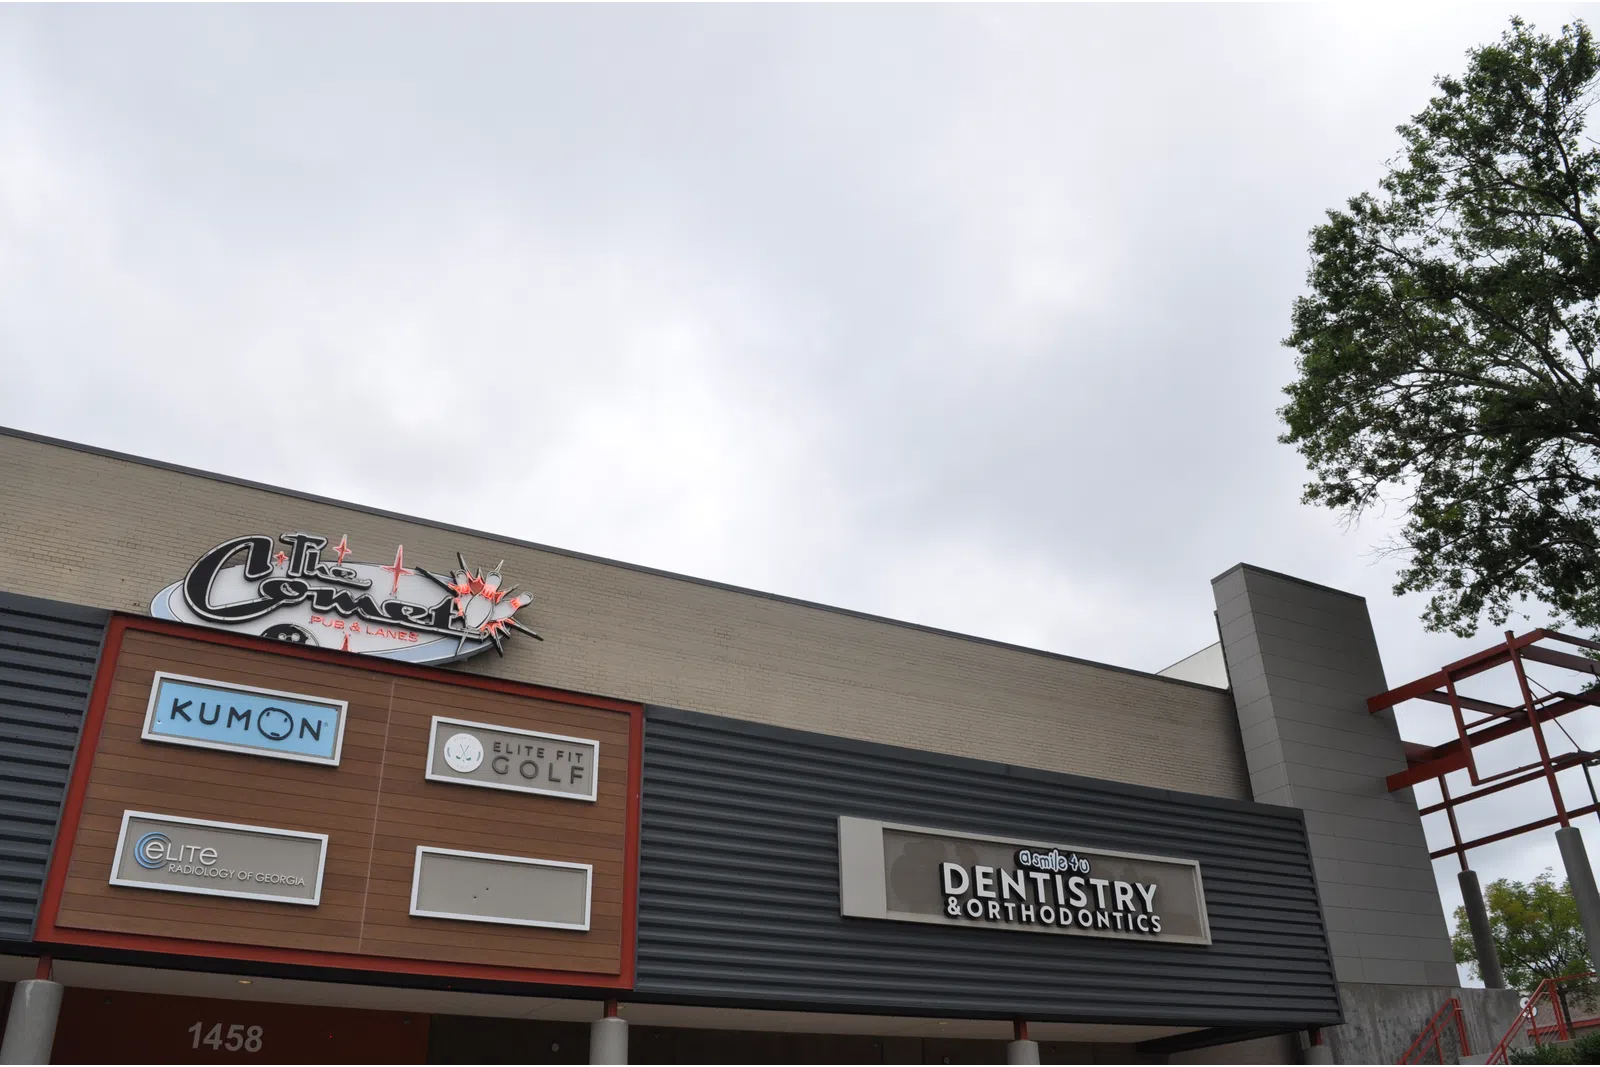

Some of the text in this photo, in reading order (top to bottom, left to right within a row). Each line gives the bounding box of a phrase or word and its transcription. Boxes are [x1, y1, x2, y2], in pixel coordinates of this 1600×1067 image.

[279, 532, 371, 591] The
[183, 534, 489, 641] Comet
[310, 615, 419, 642] PUB & LANES
[170, 698, 322, 741] KUMON
[493, 741, 583, 763] ELITE FIT
[492, 755, 584, 784] GOLF
[168, 863, 305, 886] RADIOLOGY OF GEORGIA
[1032, 849, 1068, 872] smile
[1069, 853, 1078, 871] 4
[942, 862, 1157, 913] DENTISTRY
[188, 1022, 263, 1053] 1458
